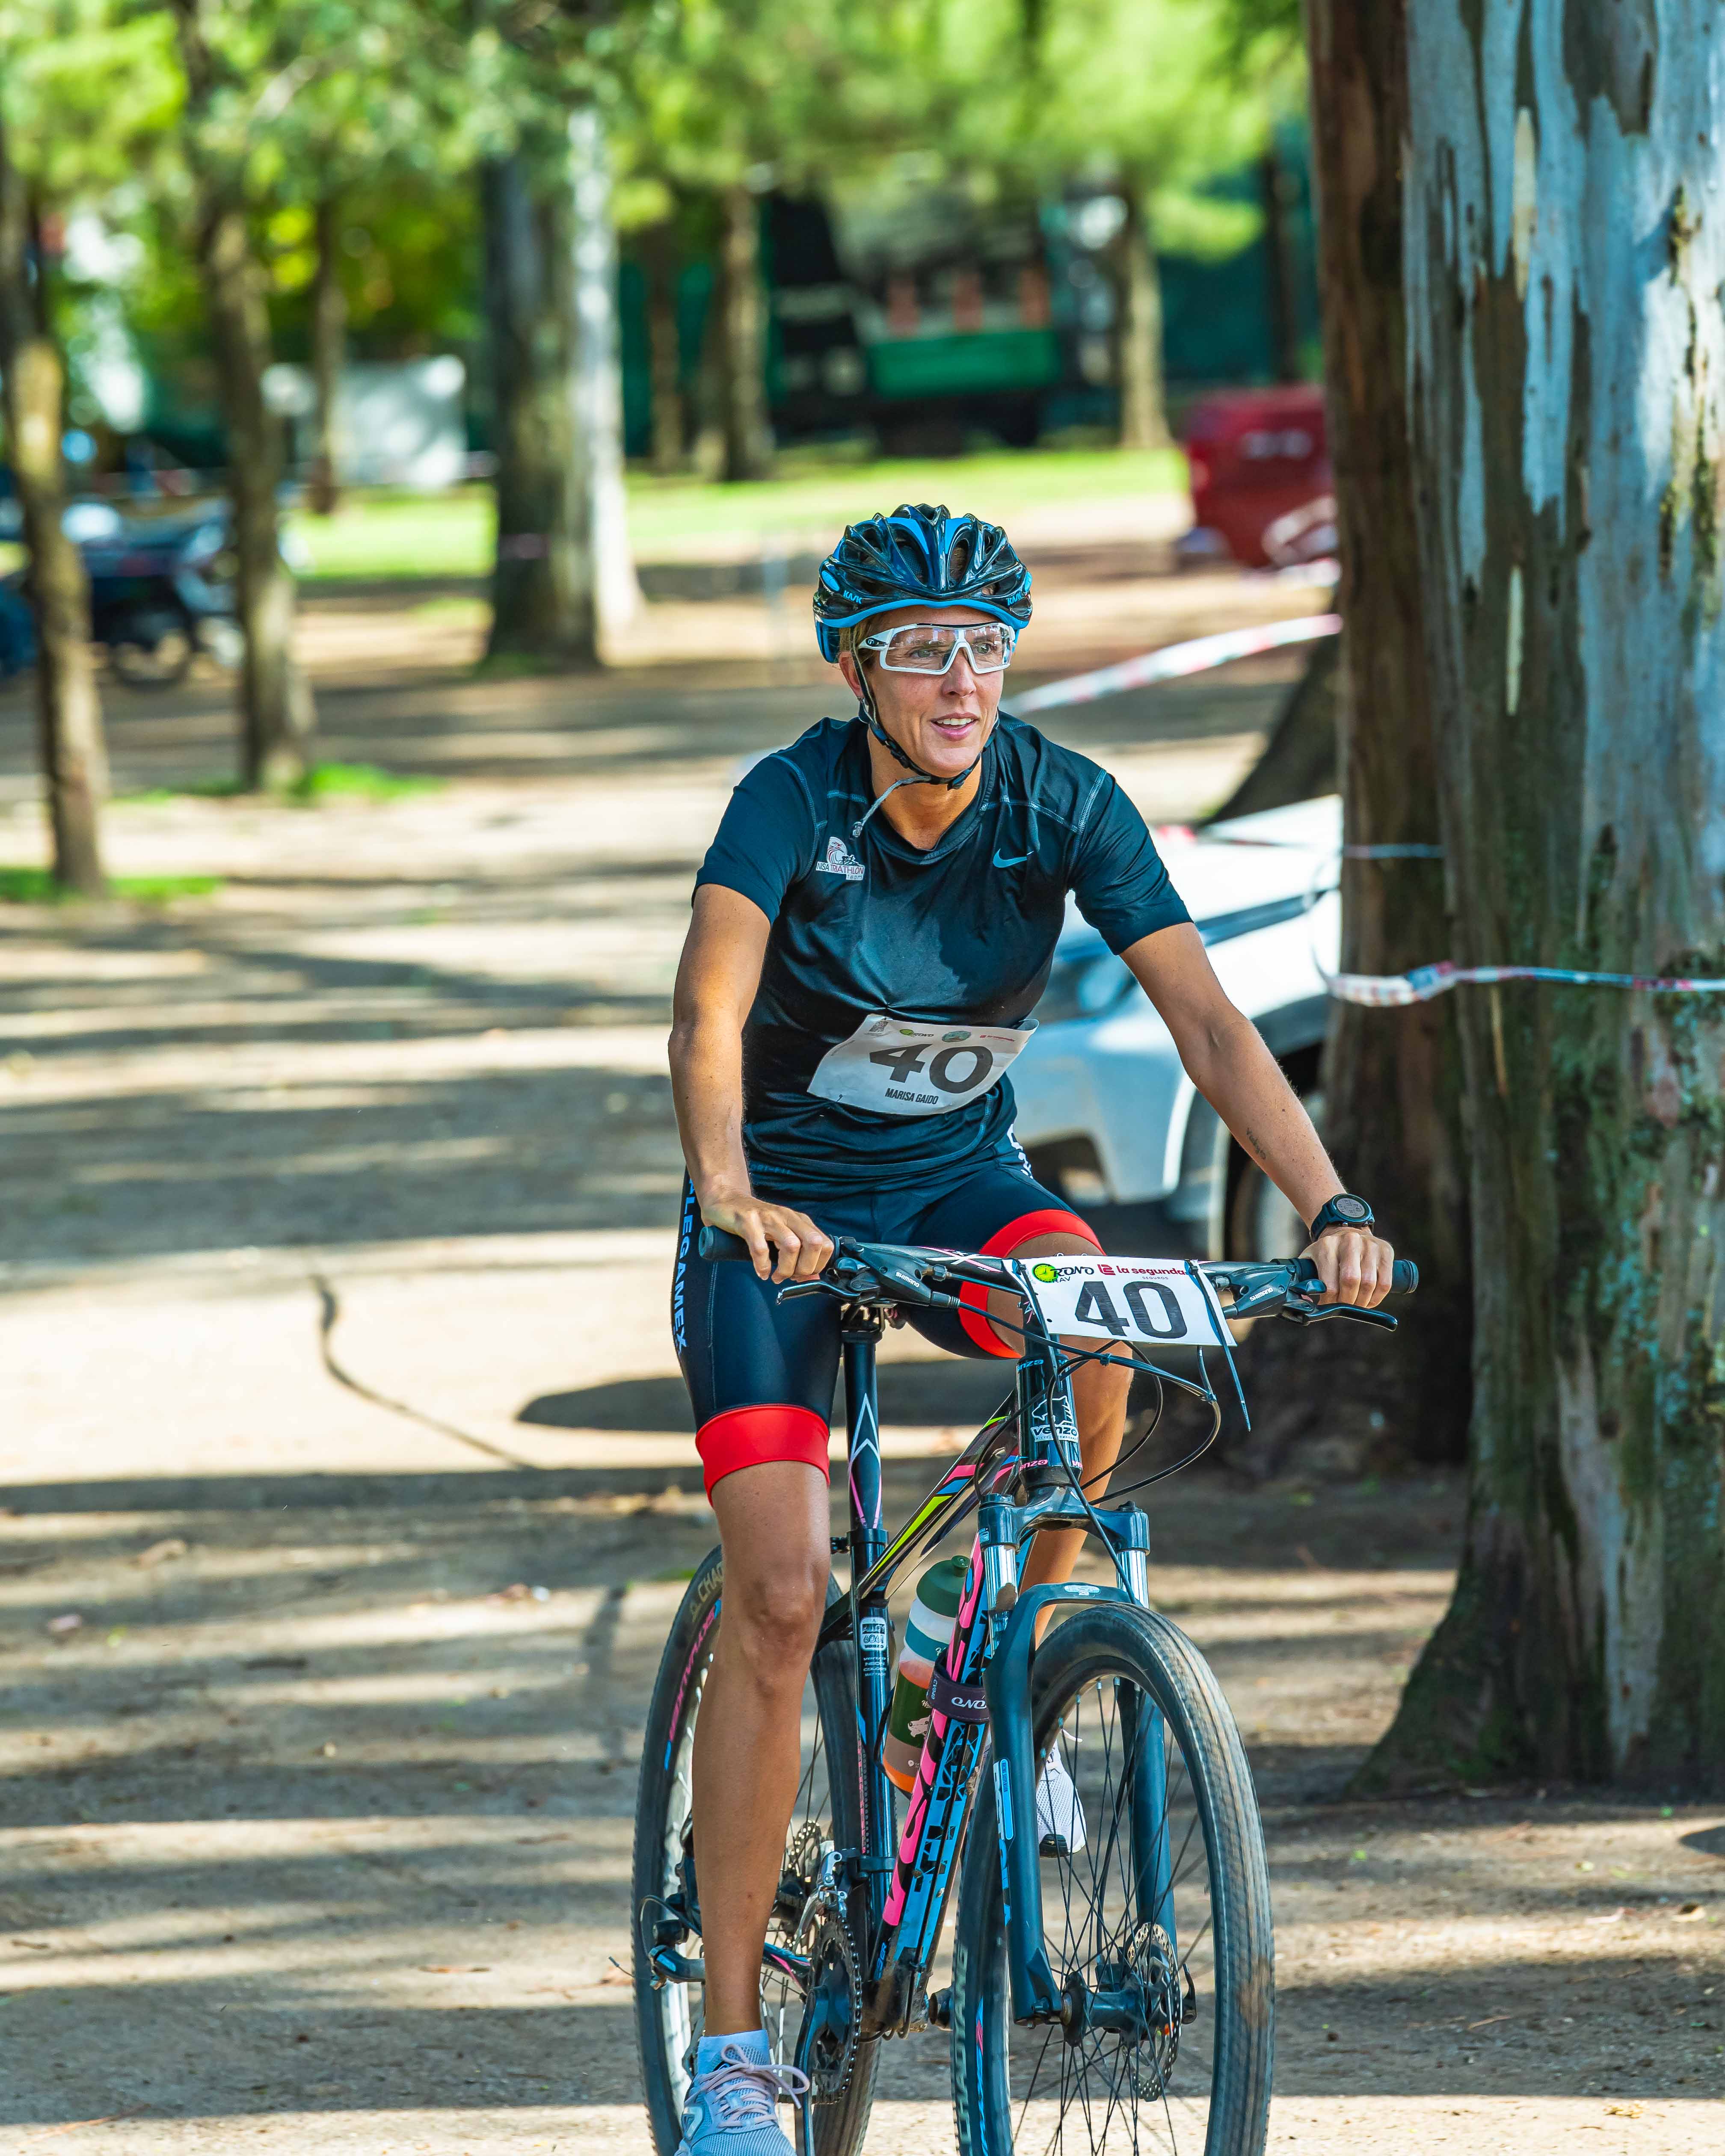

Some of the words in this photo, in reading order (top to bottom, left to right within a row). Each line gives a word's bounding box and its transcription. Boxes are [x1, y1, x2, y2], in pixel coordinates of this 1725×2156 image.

[830, 865, 865, 874] TRIATHLON
[869, 1044, 993, 1093] 40
[885, 1088, 915, 1102] MARISA
[916, 1094, 939, 1105] GAIDO
[1131, 1268, 1186, 1276] segunda
[895, 1271, 920, 1288] SHIMANO
[1249, 1287, 1274, 1302] SHIMANO
[1075, 1281, 1187, 1339] 40
[1017, 1359, 1044, 1372] enzo
[1033, 1426, 1077, 1436] venzo
[1020, 1459, 1048, 1472] enzo
[863, 1634, 884, 1644] 6061
